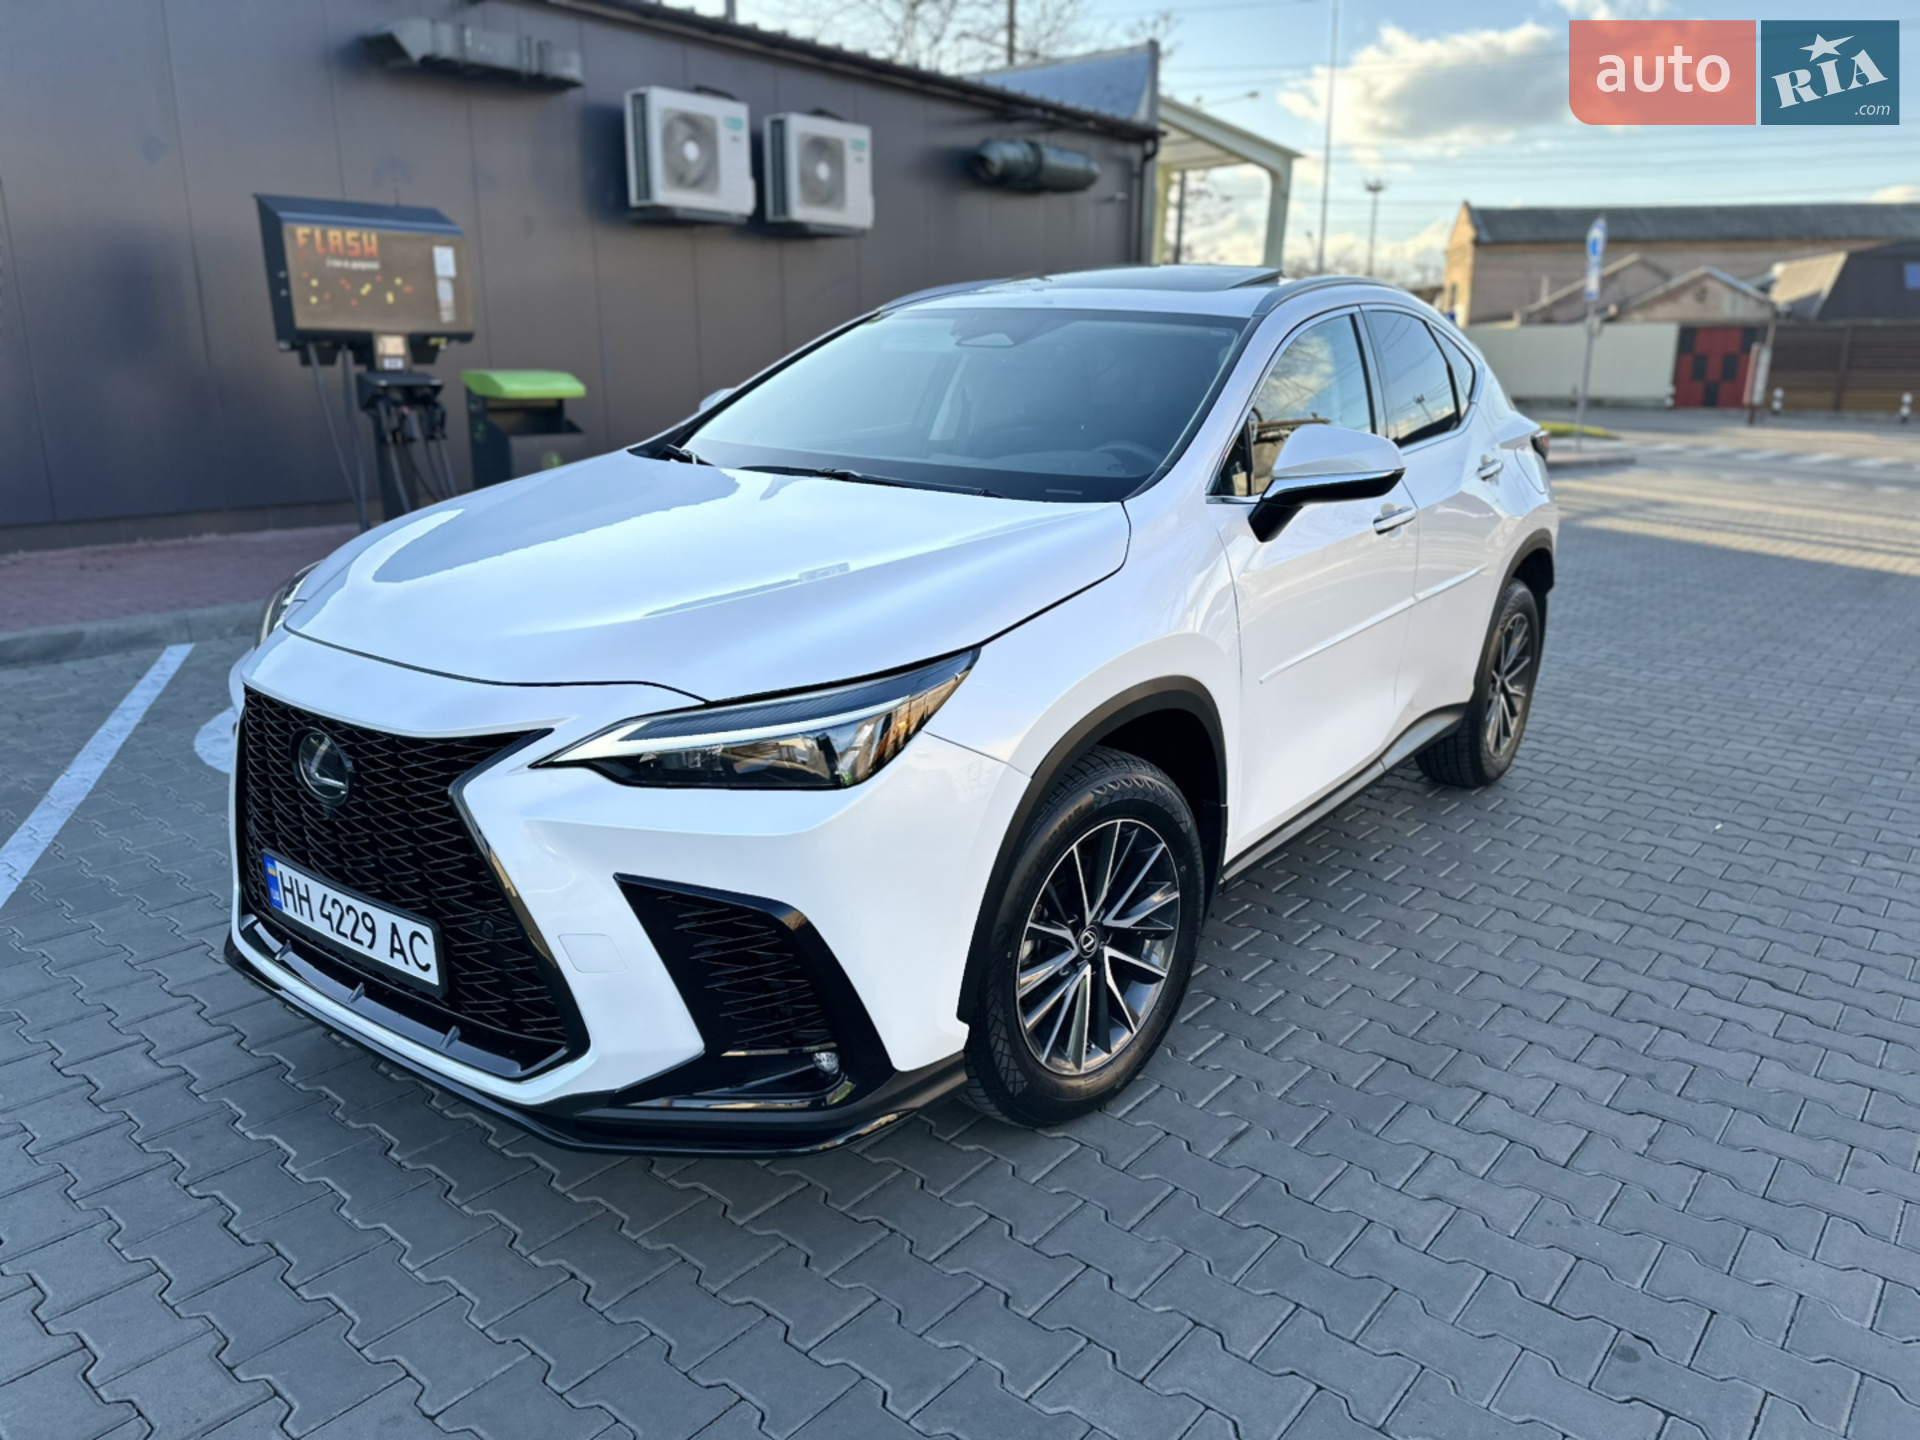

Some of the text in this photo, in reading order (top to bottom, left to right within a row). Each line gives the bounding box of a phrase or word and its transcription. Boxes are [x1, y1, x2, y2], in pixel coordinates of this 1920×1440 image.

[279, 870, 432, 973] HH 4229 AC
